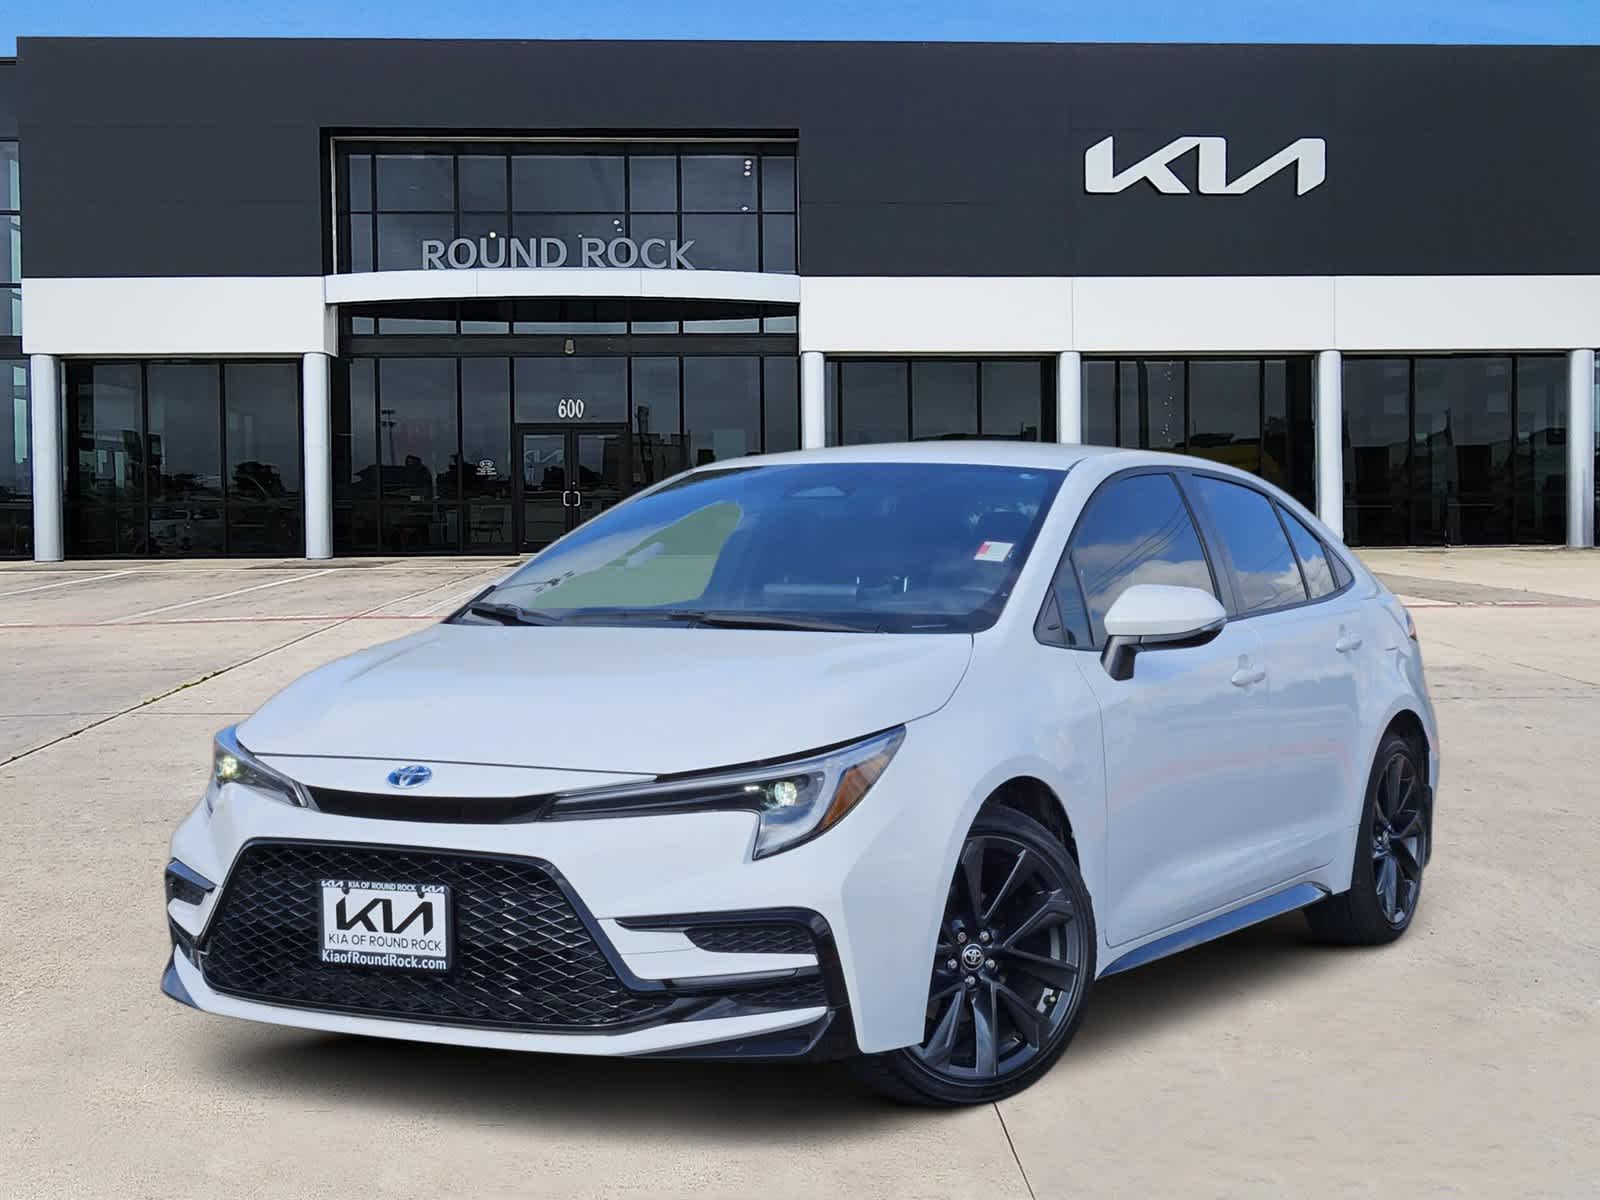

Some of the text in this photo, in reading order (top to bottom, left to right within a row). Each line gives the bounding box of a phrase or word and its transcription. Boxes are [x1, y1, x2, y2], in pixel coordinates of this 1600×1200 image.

[1084, 135, 1326, 196] KIA
[421, 237, 696, 270] ROUND ROCK
[557, 398, 585, 419] 600
[348, 881, 360, 889] KIA
[371, 882, 396, 891] ROUND
[397, 884, 417, 892] ROCK
[336, 896, 434, 936] KIA
[328, 933, 441, 952] KIA OF ROUND ROCK
[321, 949, 447, 970] KiaofRoundRock.com
